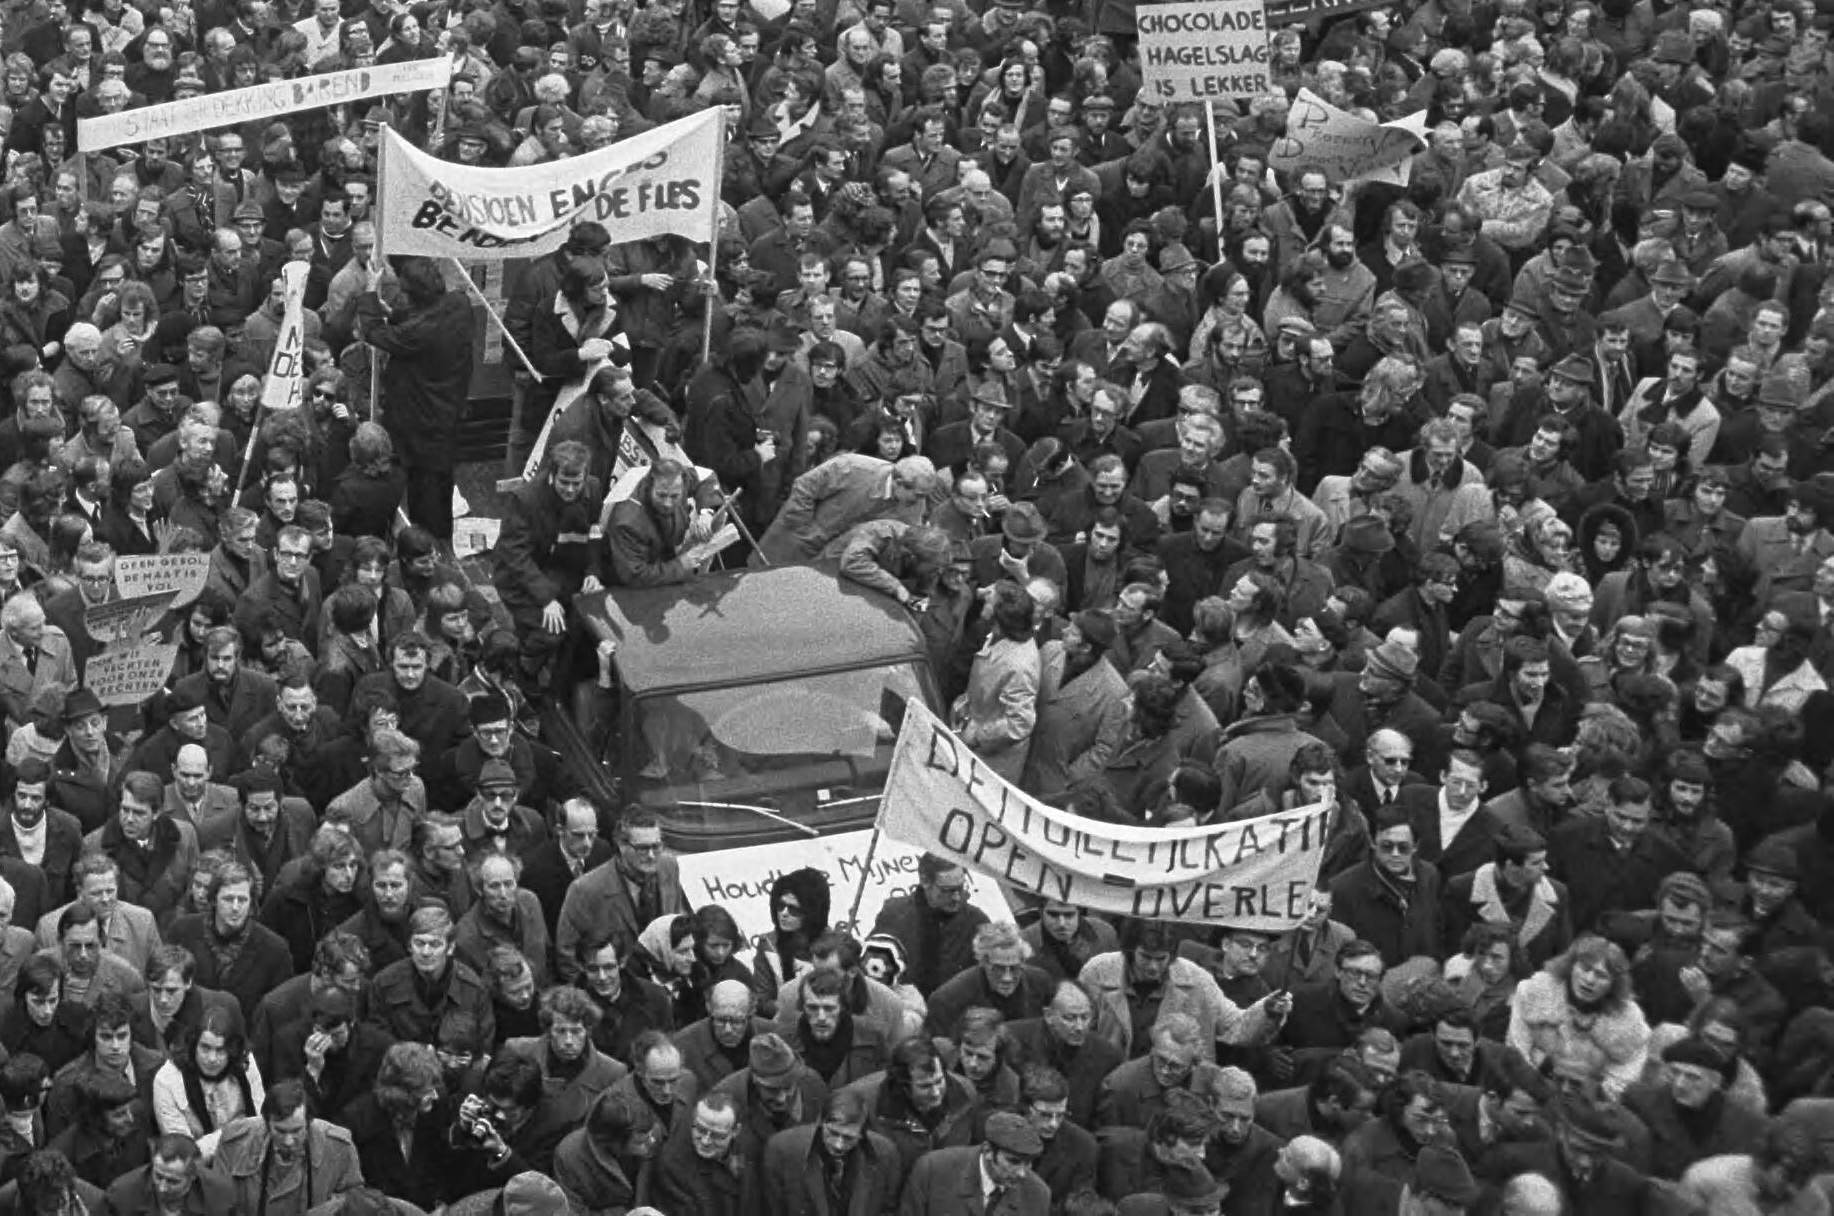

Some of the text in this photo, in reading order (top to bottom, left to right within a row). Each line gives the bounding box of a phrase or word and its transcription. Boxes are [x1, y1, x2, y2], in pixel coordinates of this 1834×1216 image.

[1137, 9, 1263, 34] CHOCOLADE
[1147, 45, 1268, 66] HAGELSLAG
[292, 72, 370, 105] BAREND
[1155, 74, 1268, 96] IS LEKKER
[595, 187, 631, 221] DE
[938, 808, 1072, 903] OPEN
